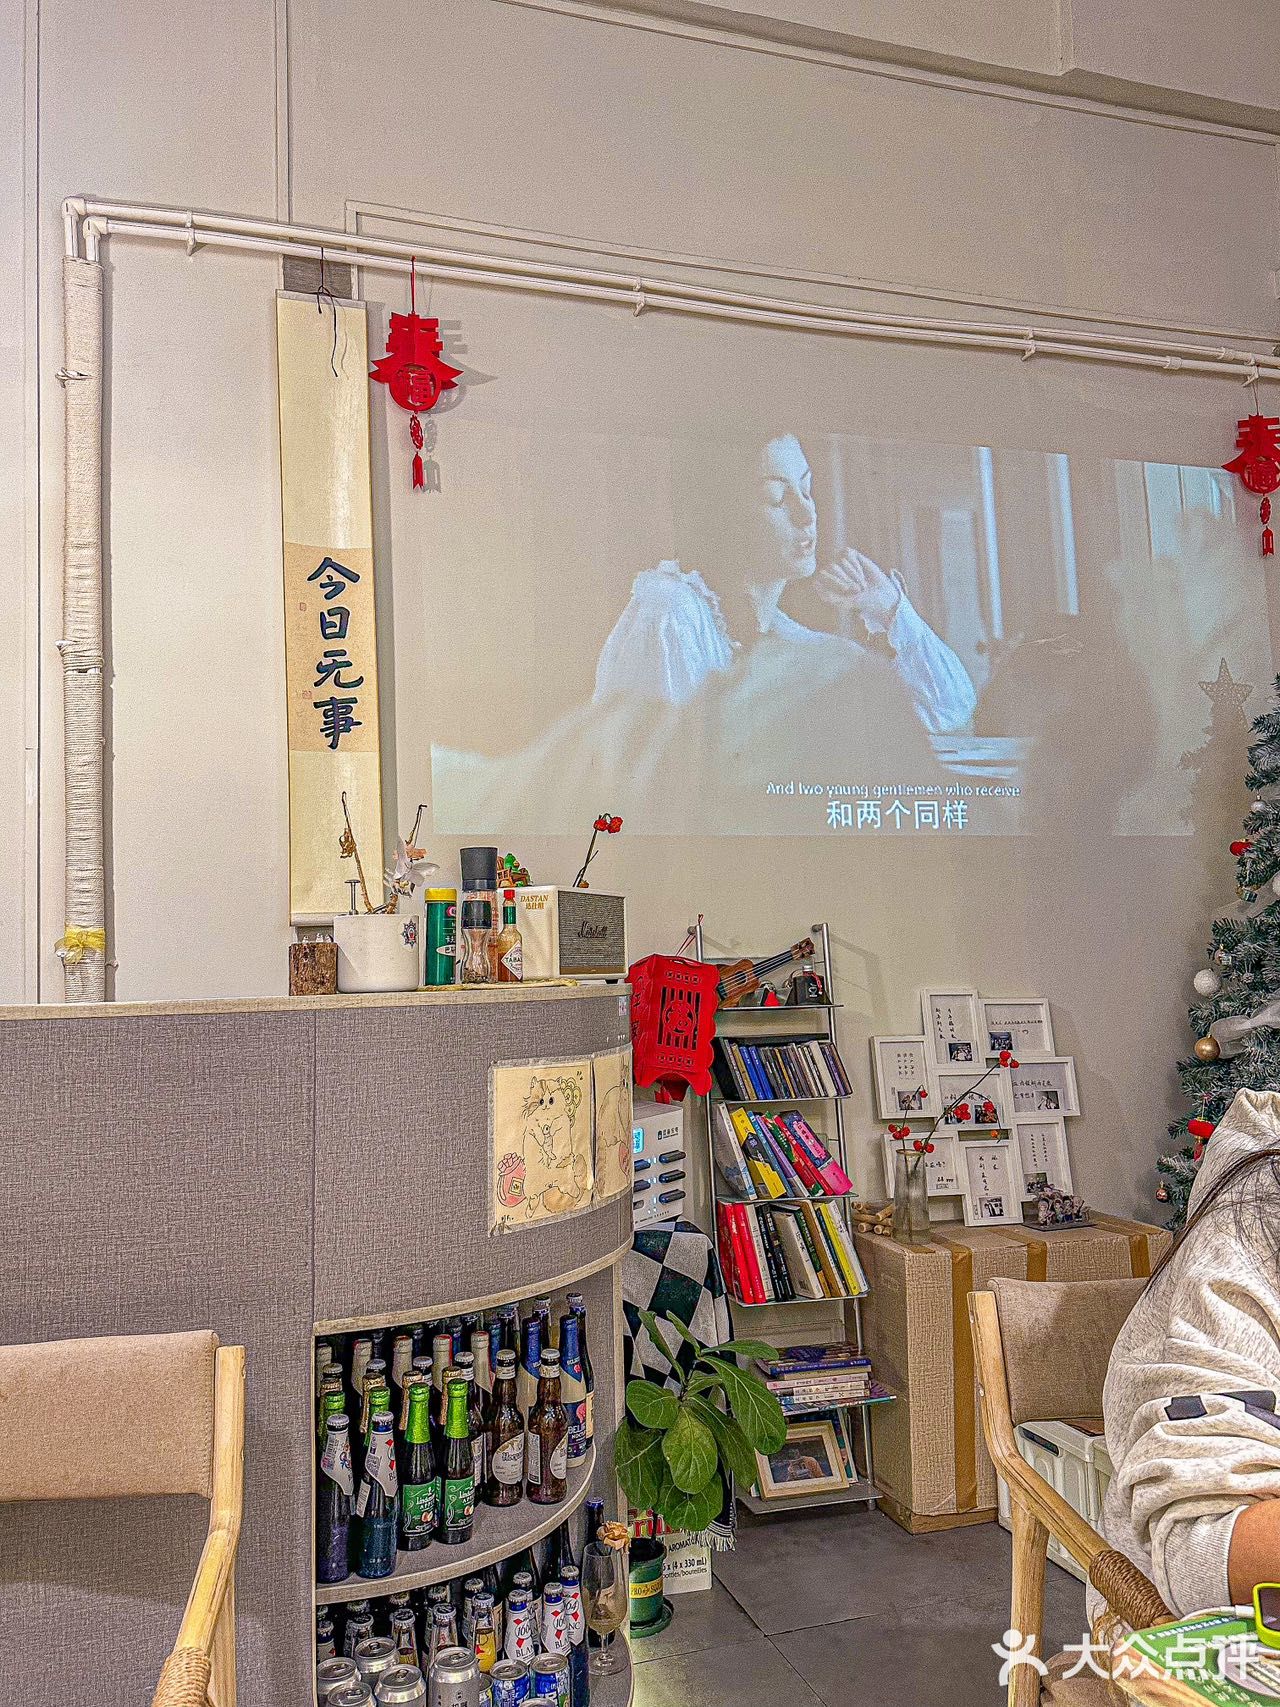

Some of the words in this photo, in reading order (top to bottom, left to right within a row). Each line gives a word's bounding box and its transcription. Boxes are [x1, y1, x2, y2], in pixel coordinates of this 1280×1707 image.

[307, 556, 364, 750] 今日无事
[766, 781, 794, 795] And
[798, 783, 824, 796] two
[827, 784, 869, 799] young
[873, 783, 943, 798] gentlemen
[946, 782, 973, 796] who
[975, 784, 1021, 797] receive
[826, 799, 969, 830] 和两个同样
[520, 894, 549, 903] DASTAN
[684, 1558, 695, 1568] 330
